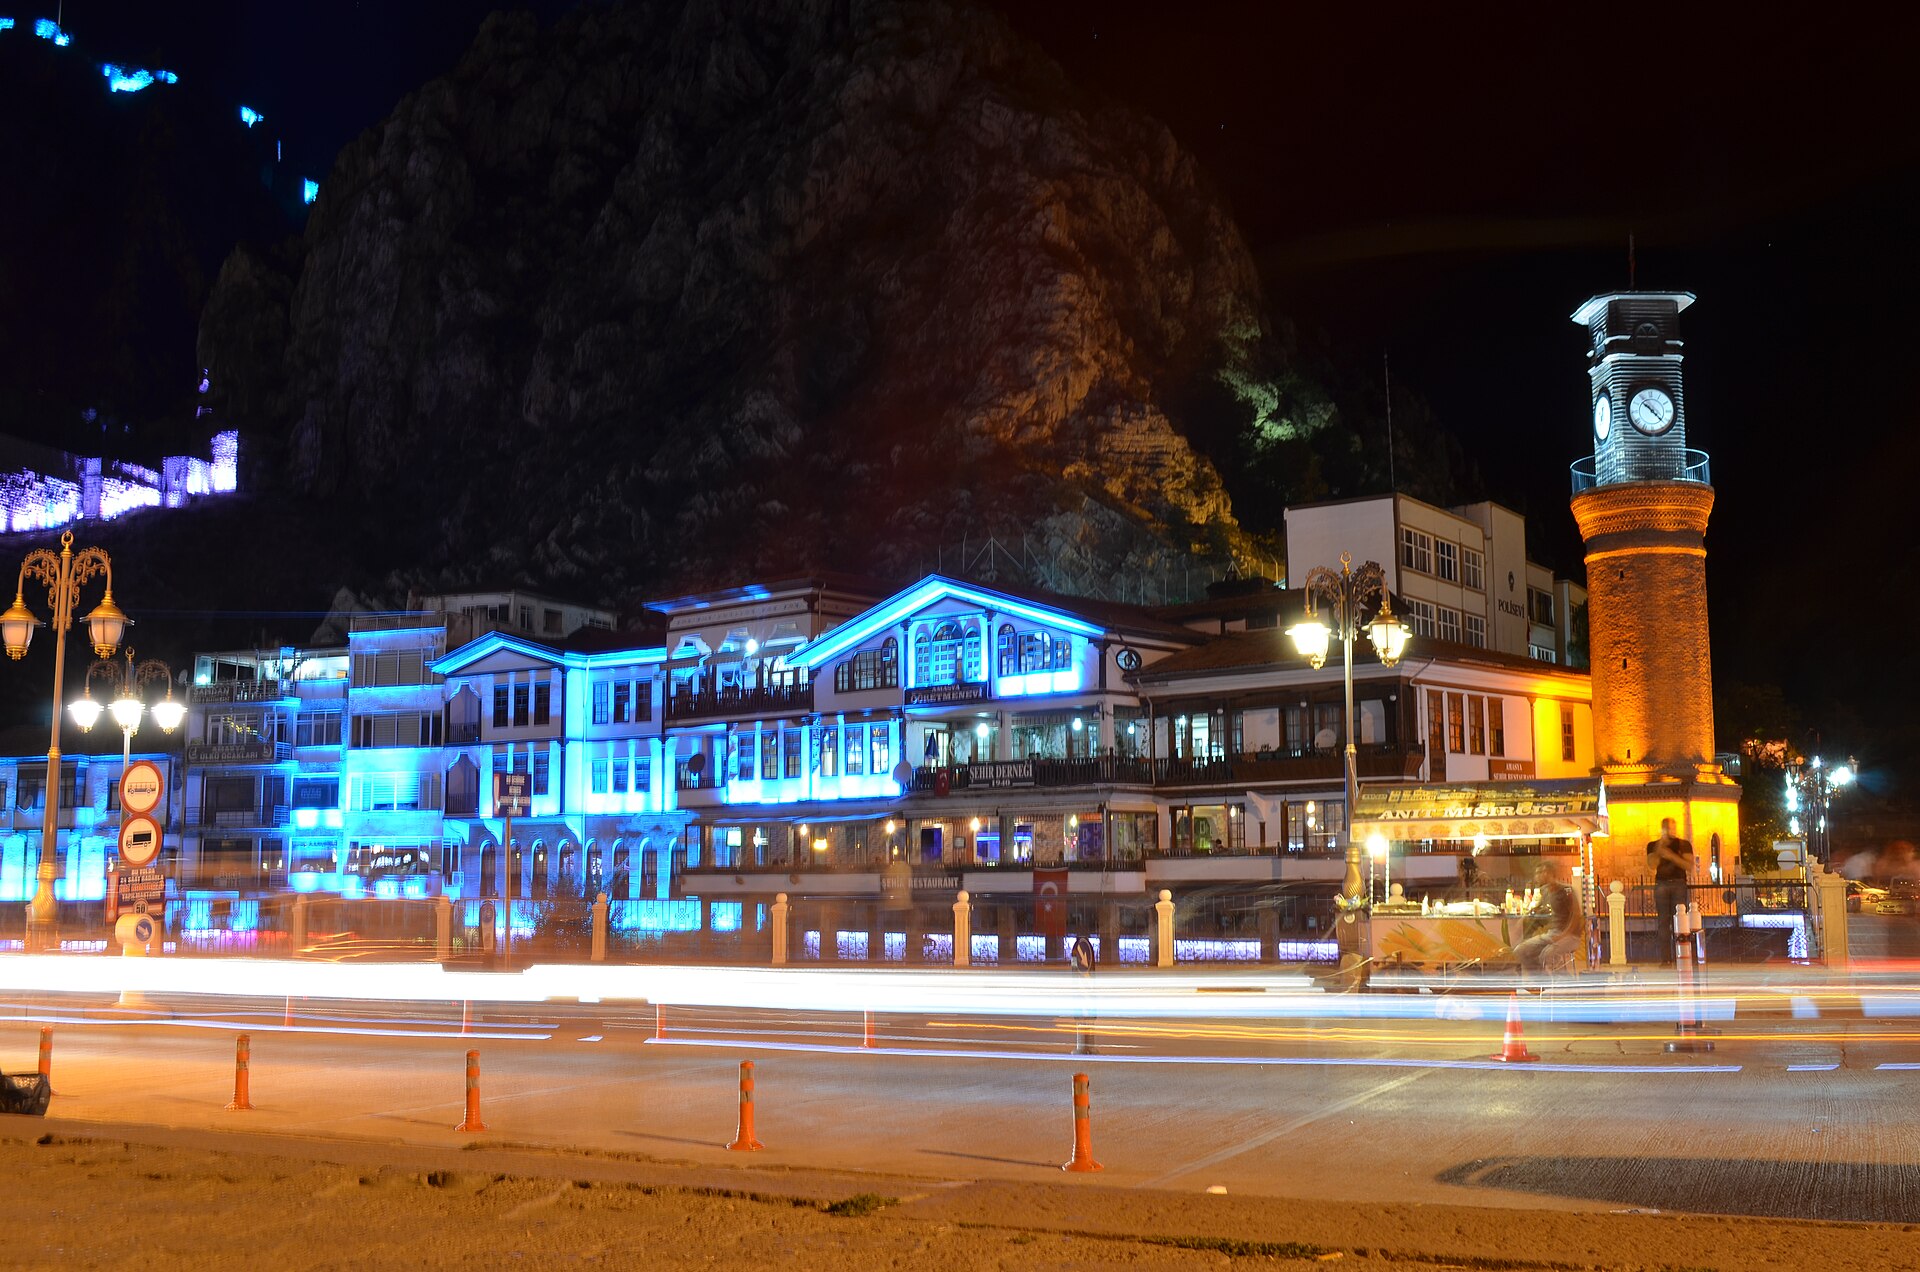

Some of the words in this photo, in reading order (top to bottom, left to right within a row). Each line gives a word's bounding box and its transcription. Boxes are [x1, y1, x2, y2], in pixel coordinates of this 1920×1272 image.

[932, 684, 960, 692] AMASYA
[970, 762, 994, 784] ŞEHİR
[995, 760, 1033, 778] DERNEĞİ
[992, 779, 1011, 788] 1940
[1378, 807, 1437, 820] ANIT
[908, 876, 959, 889] RESTAURANT
